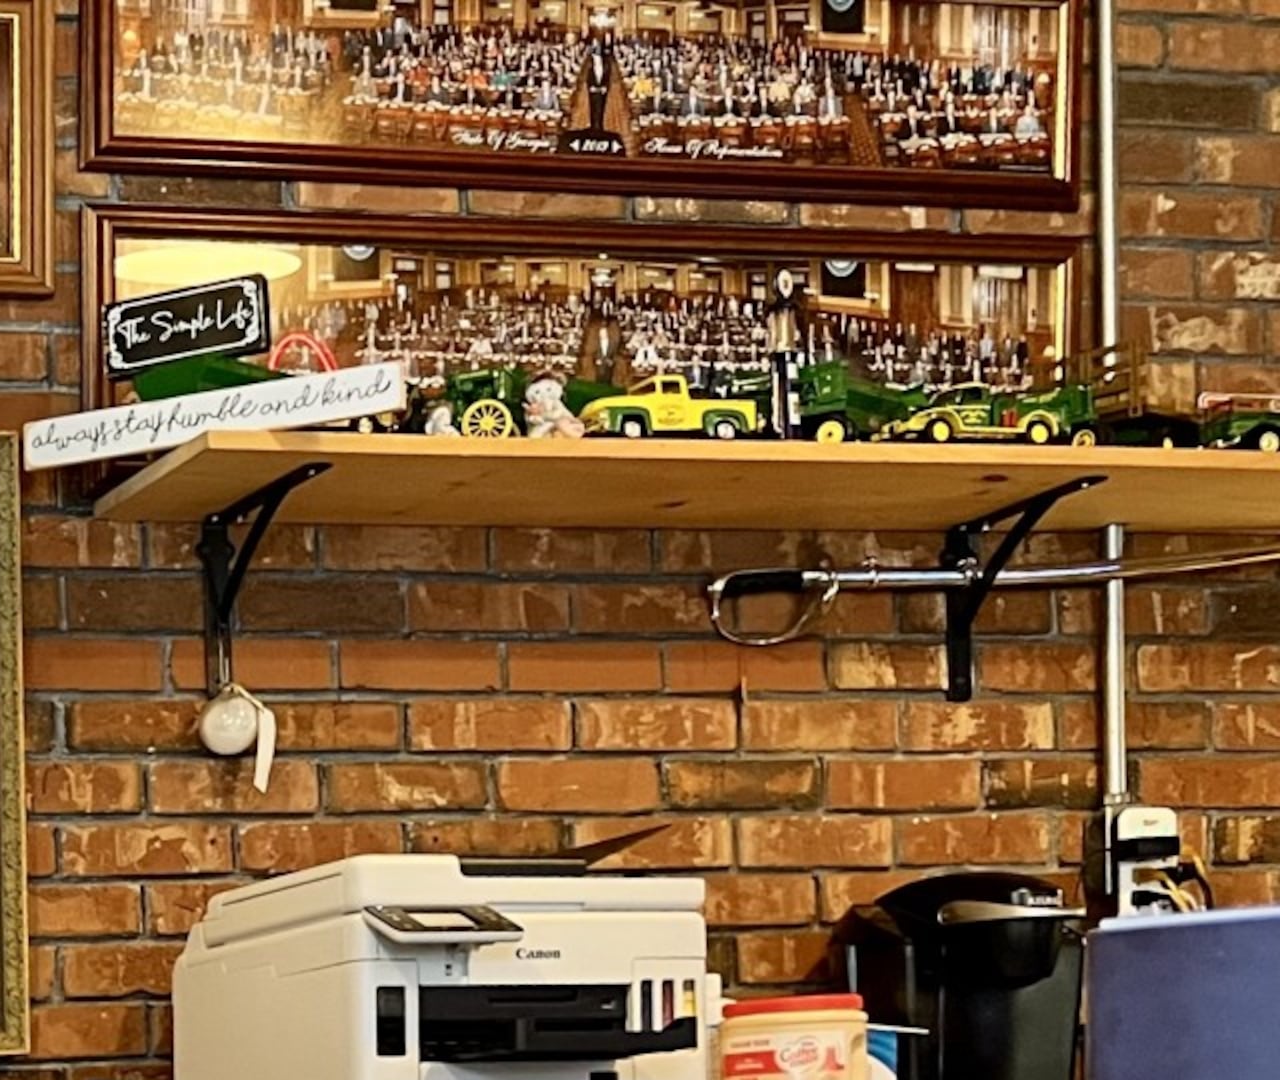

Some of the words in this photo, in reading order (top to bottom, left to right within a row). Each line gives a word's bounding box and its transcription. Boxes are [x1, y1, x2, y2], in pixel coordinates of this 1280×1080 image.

[117, 316, 152, 349] The
[151, 303, 215, 342] Simple
[216, 299, 252, 330] Life
[113, 408, 165, 443] stay
[166, 395, 259, 433] humble
[260, 379, 321, 417] and
[321, 368, 392, 407] kind
[515, 948, 561, 960] Canon
